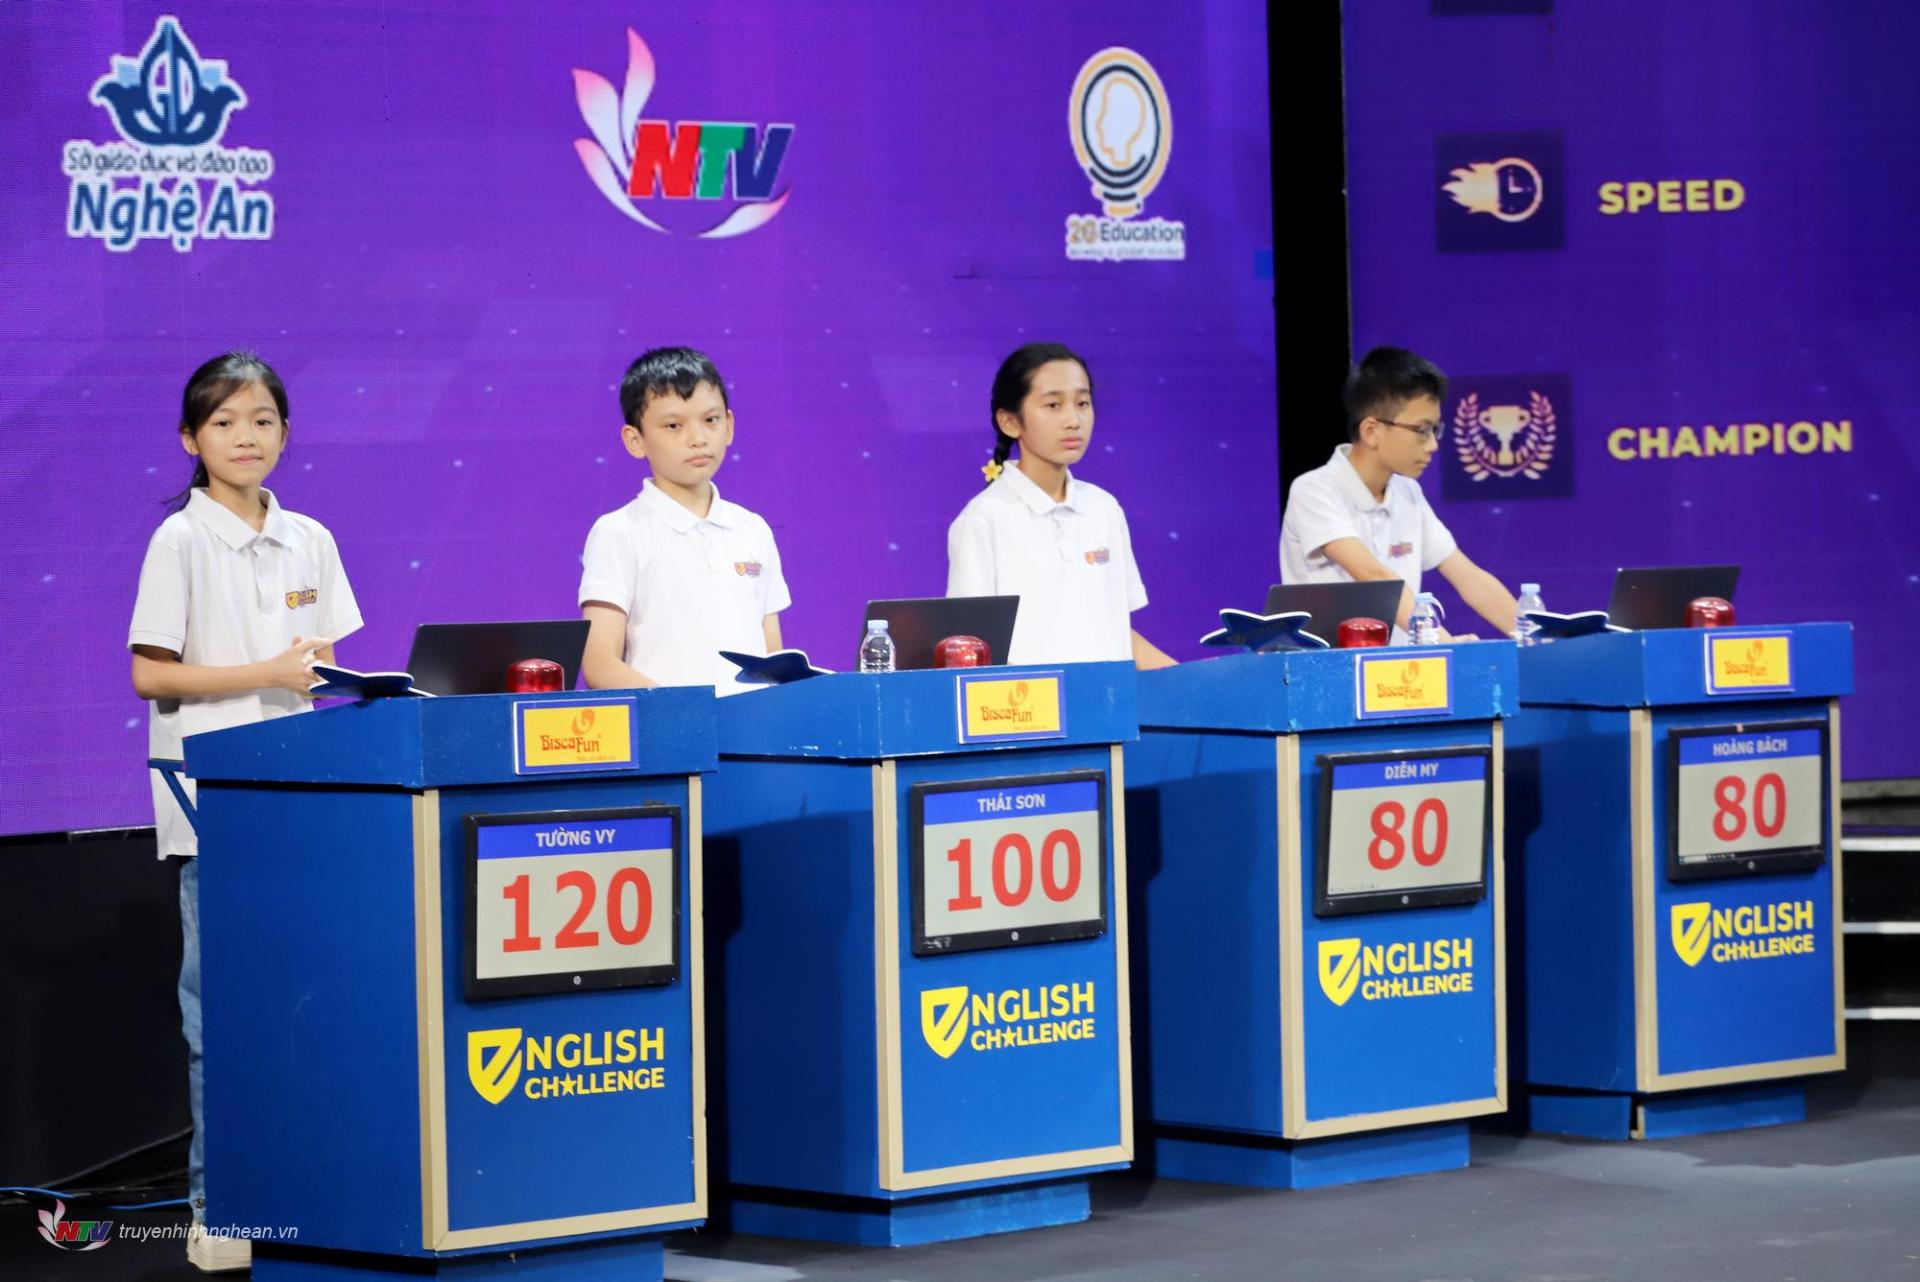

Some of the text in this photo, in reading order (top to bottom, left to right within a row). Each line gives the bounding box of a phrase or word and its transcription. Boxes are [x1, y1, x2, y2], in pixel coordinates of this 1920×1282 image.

[626, 119, 795, 201] NTV
[73, 182, 269, 247] Nghệ An
[1599, 179, 1745, 215] SPEED
[1100, 221, 1184, 242] Education
[1607, 420, 1853, 461] CHAMPION
[977, 792, 1046, 813] THÁI SƠN
[1367, 797, 1448, 871] 80
[1713, 772, 1786, 842] 80
[535, 827, 616, 848] TƯỜNG VY
[947, 828, 1081, 912] 100
[503, 866, 653, 953] 120
